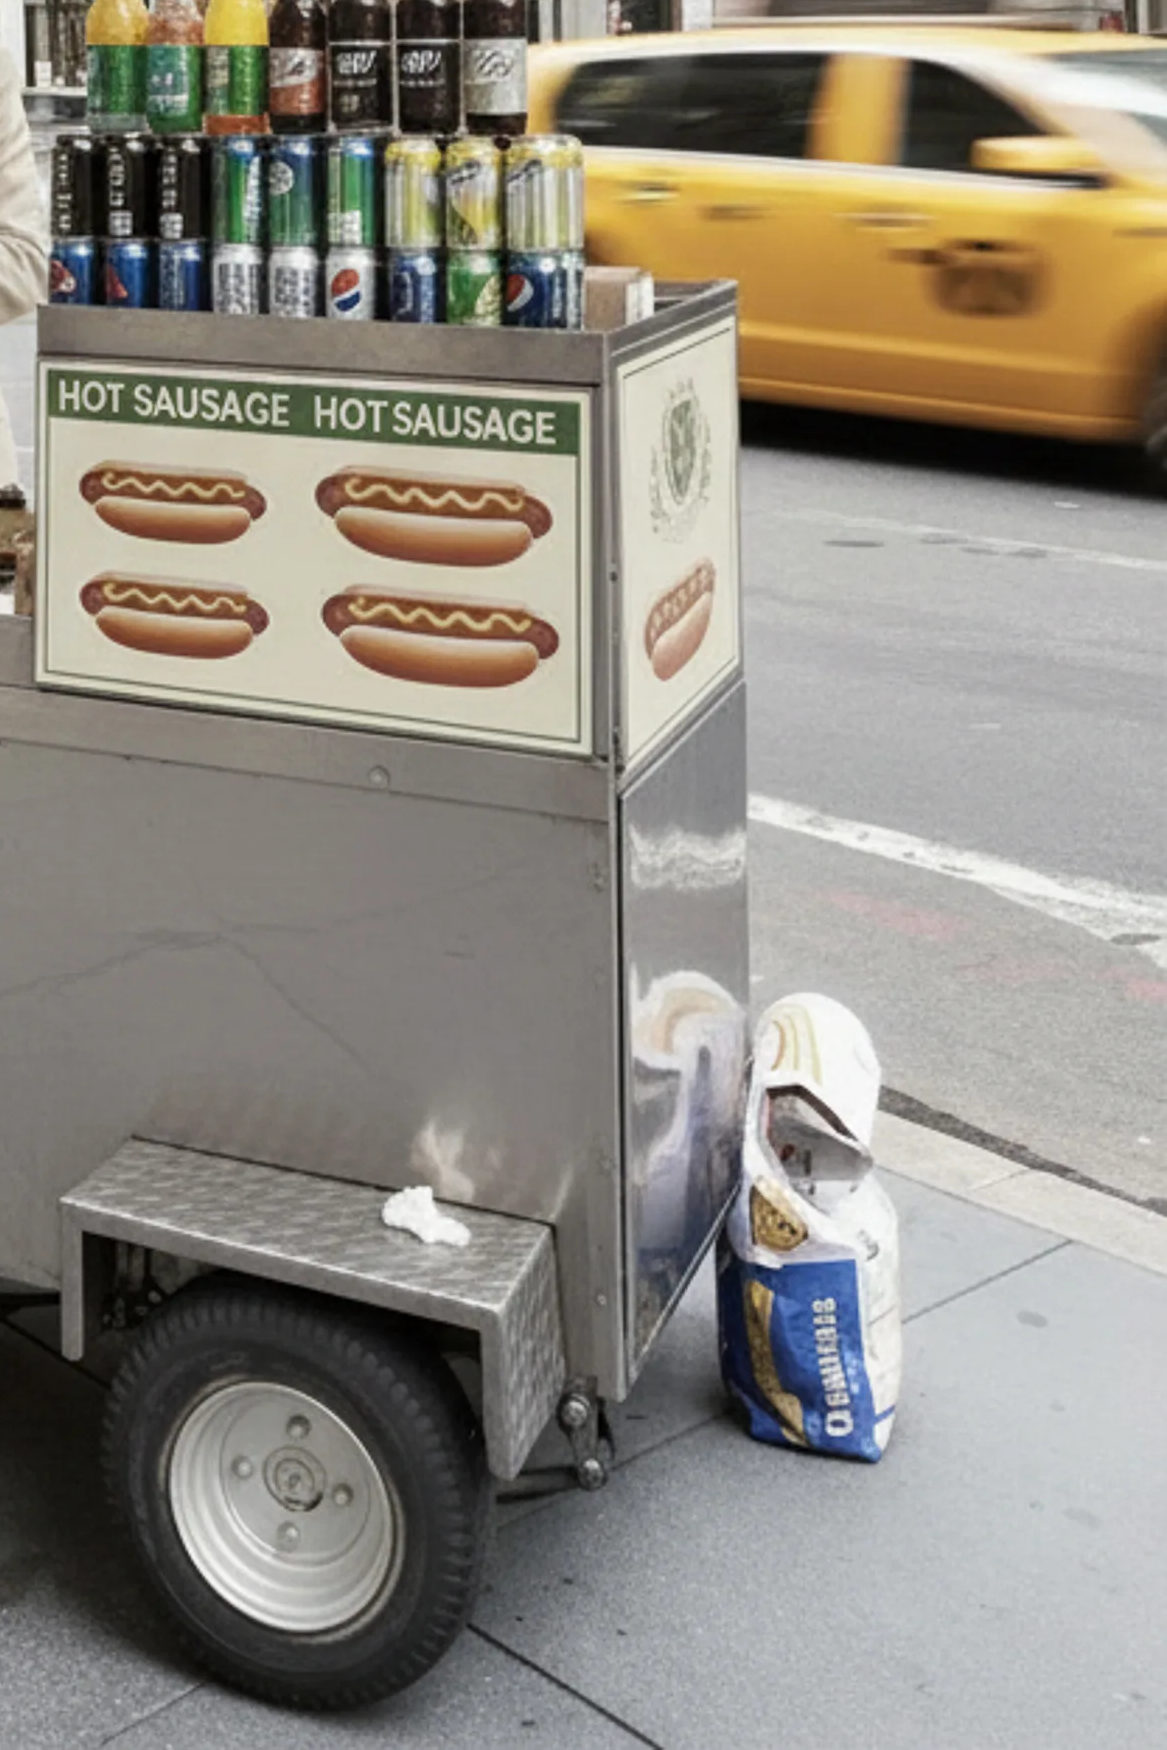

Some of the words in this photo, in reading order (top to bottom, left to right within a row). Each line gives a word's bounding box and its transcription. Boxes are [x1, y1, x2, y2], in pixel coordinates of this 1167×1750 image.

[57, 379, 125, 415] HOT
[133, 384, 290, 428] SAUSAGE
[313, 395, 389, 436] HOT
[391, 400, 557, 446] SAUSAGE
